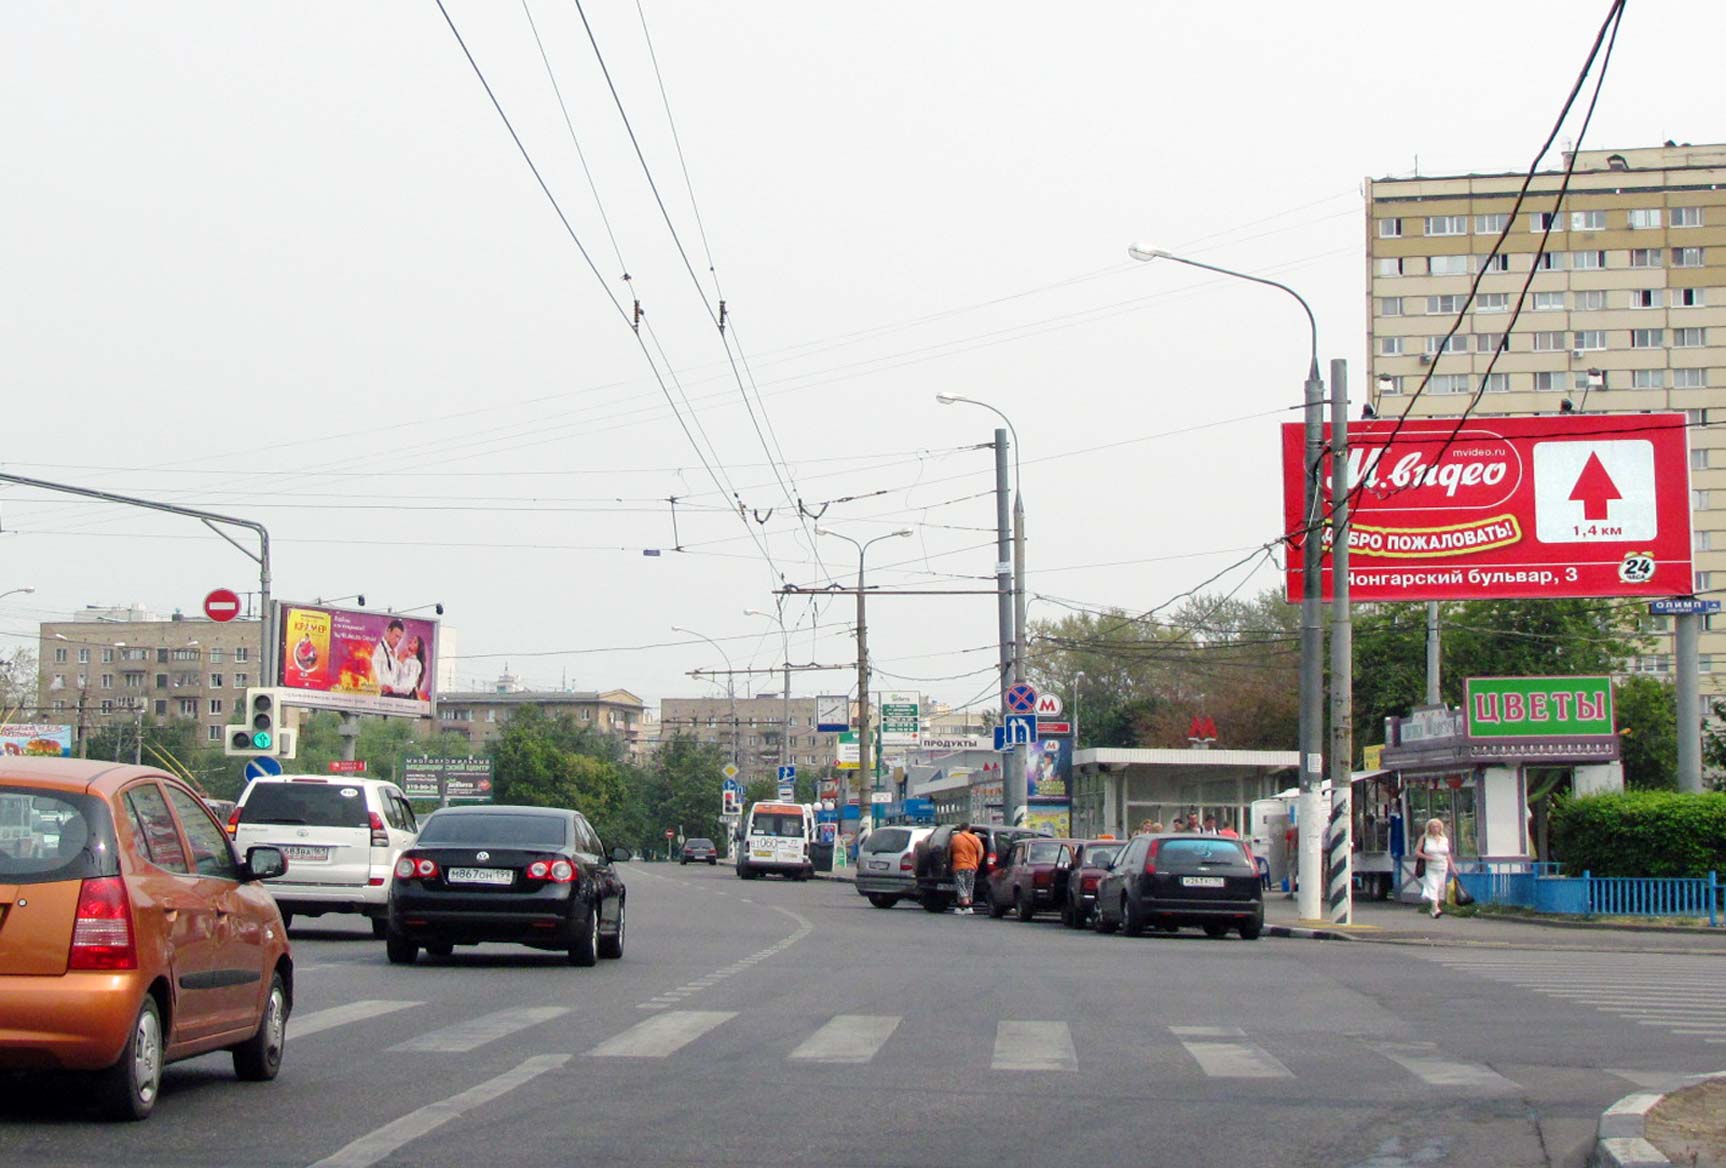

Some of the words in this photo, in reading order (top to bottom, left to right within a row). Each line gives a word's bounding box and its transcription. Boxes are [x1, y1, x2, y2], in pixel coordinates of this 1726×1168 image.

[1452, 448, 1506, 457] mvideo.ru
[1322, 526, 1382, 549] ДБРО
[1387, 521, 1512, 551] ПОЖАЛОВАТЬ!
[1573, 525, 1597, 537] 1,4
[1623, 559, 1650, 575] 24
[1468, 568, 1559, 586] бульвар,
[1565, 567, 1578, 582] 3
[1655, 601, 1702, 609] ОЛИМП
[1474, 692, 1606, 724] ЦВЕТЫ
[923, 739, 977, 748] ПРОДУКТЫ
